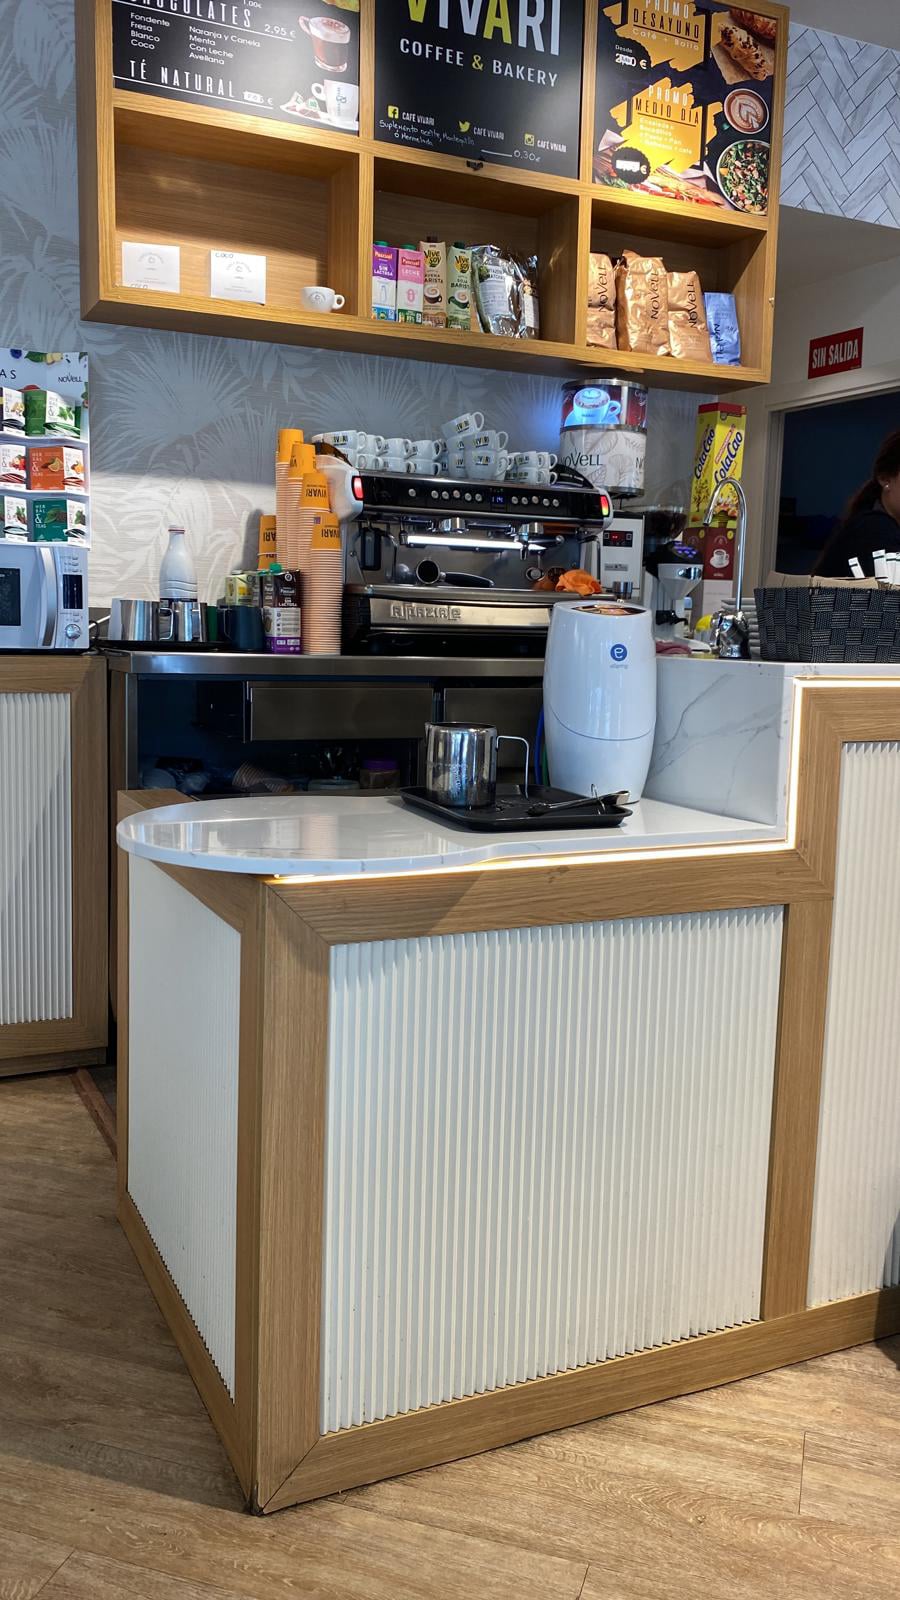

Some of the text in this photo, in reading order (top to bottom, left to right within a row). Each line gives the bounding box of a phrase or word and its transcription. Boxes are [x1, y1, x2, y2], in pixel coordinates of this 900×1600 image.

[130, 12, 170, 27] Fondente
[130, 22, 153, 32] Fresa
[633, 9, 699, 39] DESAYUNO
[130, 30, 160, 42] Blanco
[130, 39, 155, 50] Coco
[189, 26, 221, 40] Naranja
[230, 35, 261, 47] Canela
[189, 35, 216, 46] Menta
[189, 43, 234, 59] Con Leche
[189, 52, 226, 65] Avellana
[399, 38, 559, 88] COFFEE & BAKERY
[130, 59, 147, 80] TÉ
[161, 66, 236, 98] NATURAL
[648, 85, 689, 107] PROMO
[635, 98, 672, 119] MEDIO
[812, 338, 859, 369] SIN SALIDA
